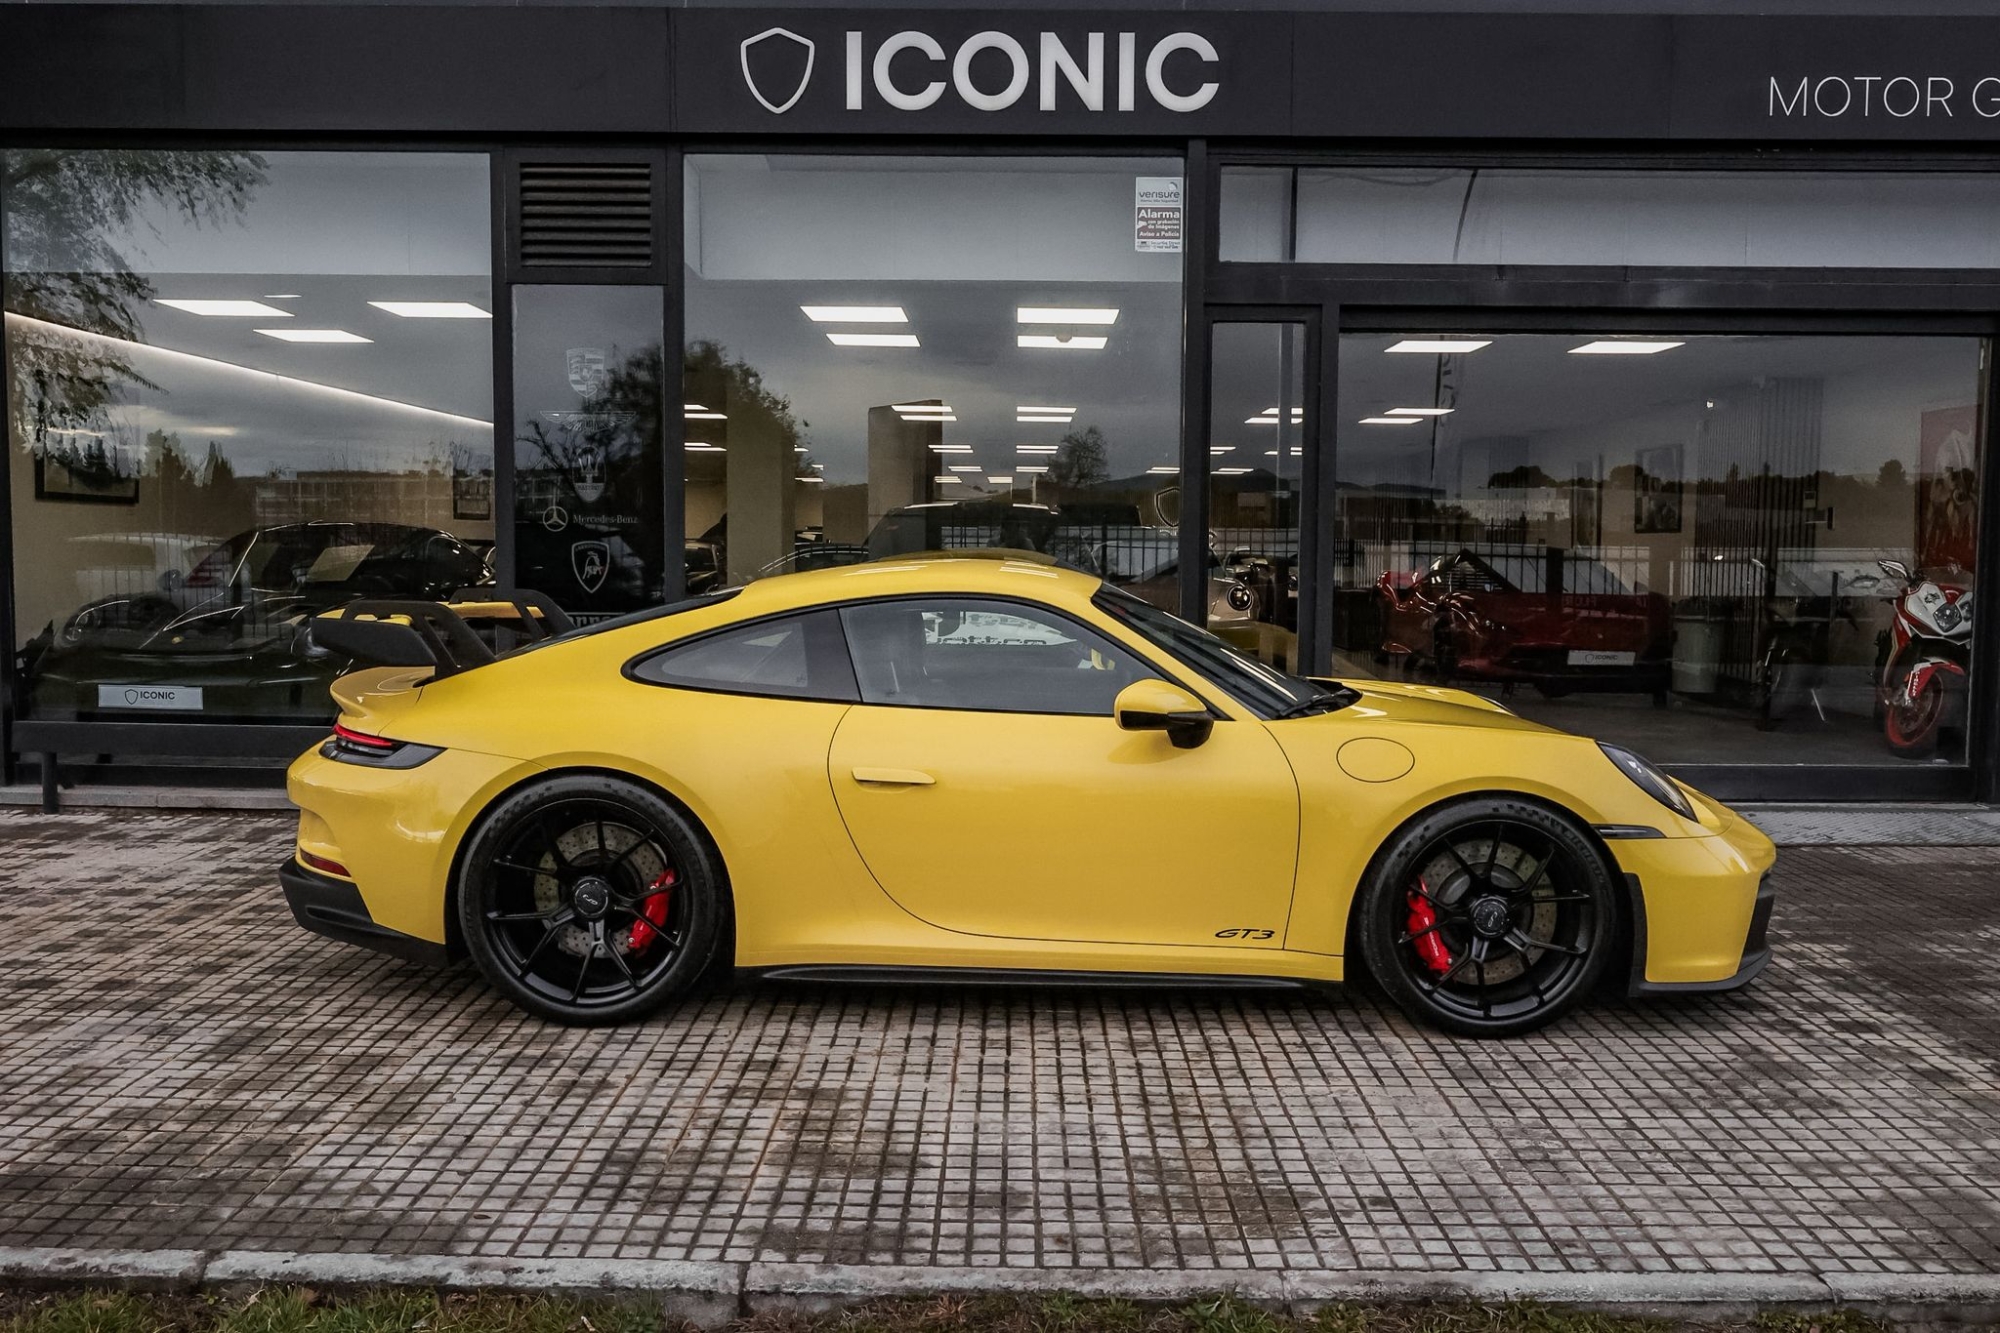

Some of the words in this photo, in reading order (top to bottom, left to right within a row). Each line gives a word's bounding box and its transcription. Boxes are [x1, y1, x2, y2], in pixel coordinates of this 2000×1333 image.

[846, 31, 1220, 112] ICONIC
[1769, 76, 1954, 117] MOTOR
[1139, 191, 1180, 199] verisure
[1138, 209, 1180, 219] Alarma
[573, 515, 638, 524] Mercedes-Benz
[140, 691, 175, 700] ICONIC
[1215, 928, 1275, 940] GT3
